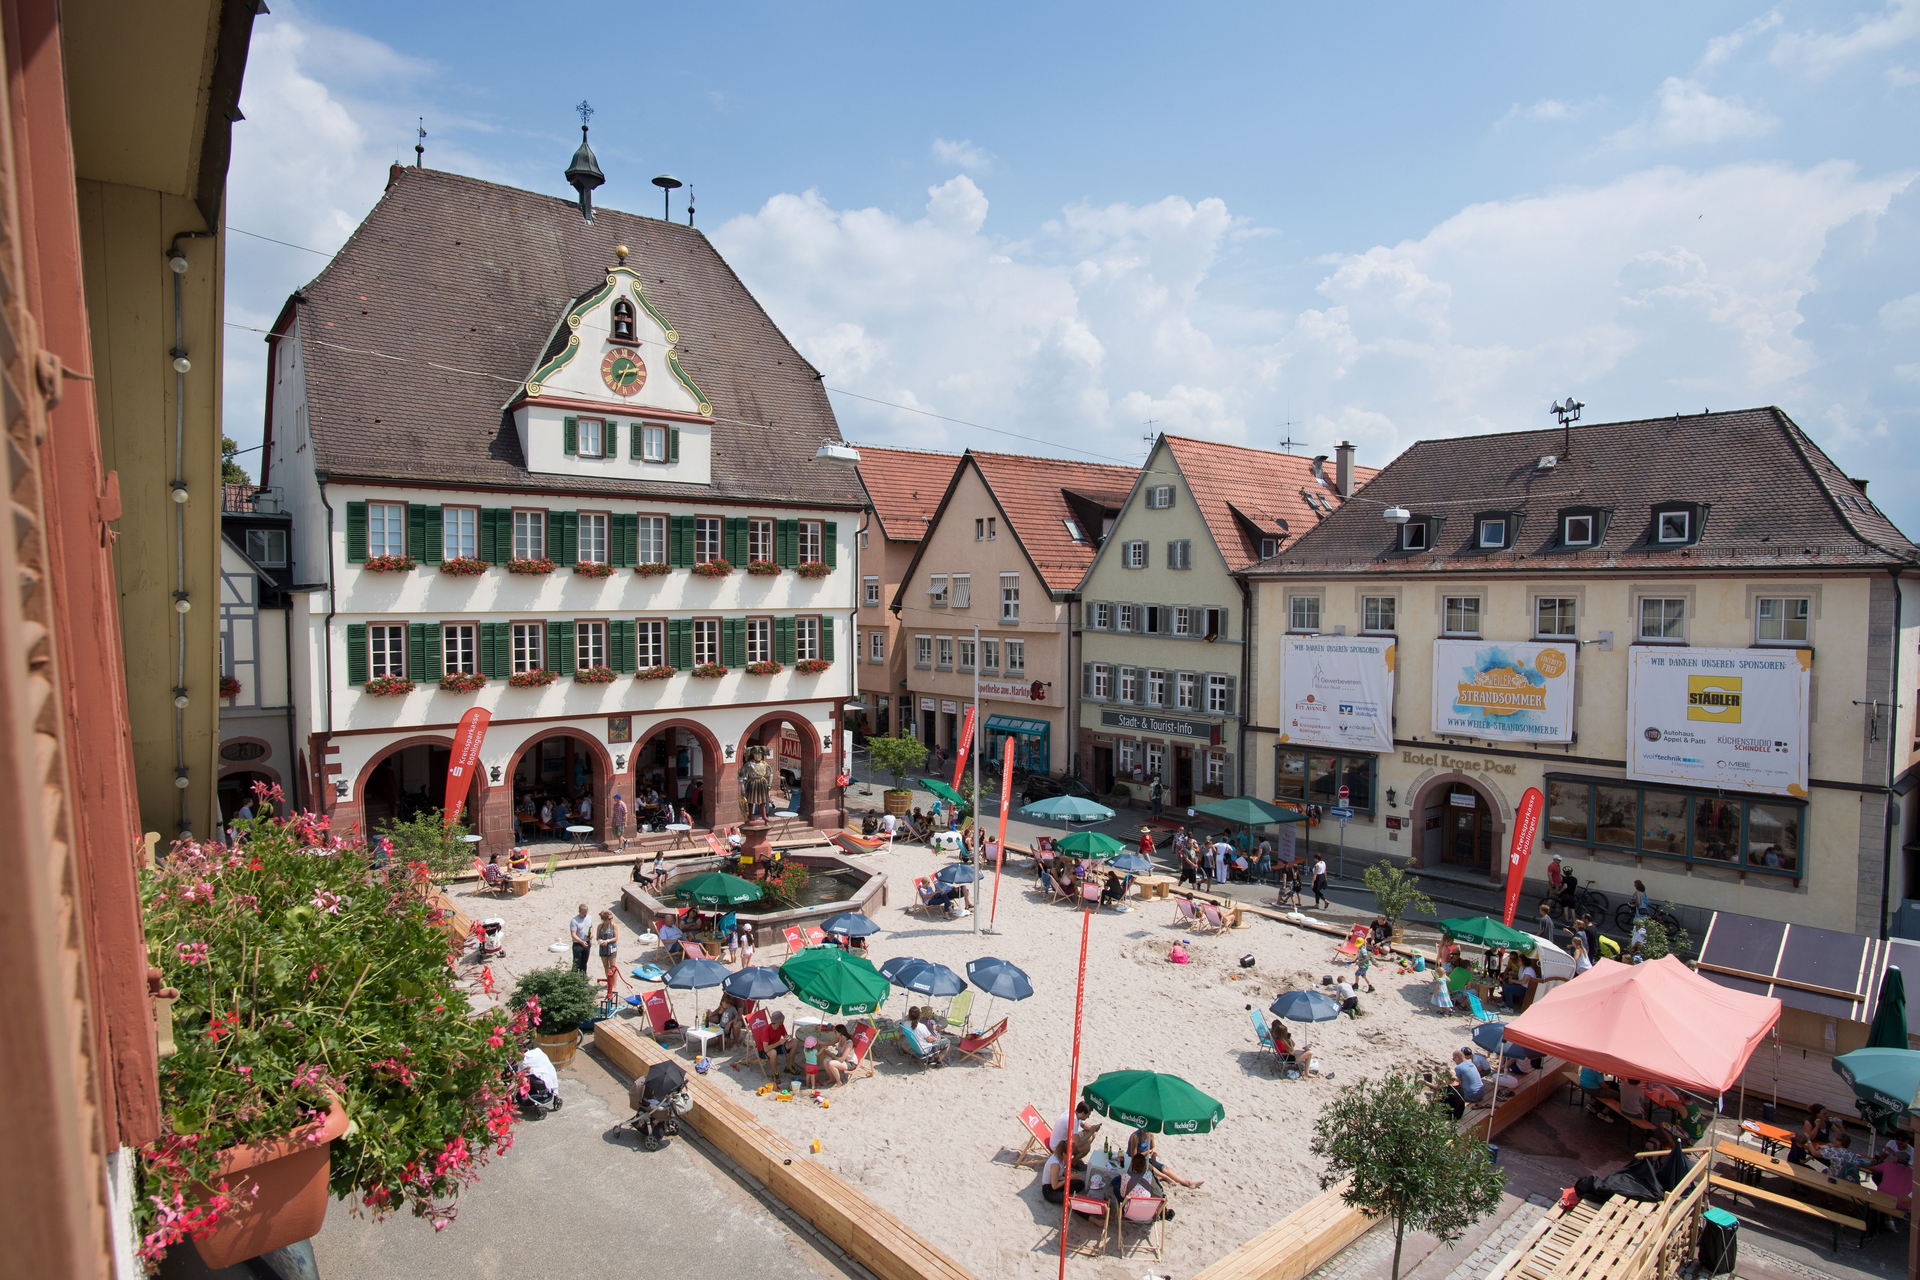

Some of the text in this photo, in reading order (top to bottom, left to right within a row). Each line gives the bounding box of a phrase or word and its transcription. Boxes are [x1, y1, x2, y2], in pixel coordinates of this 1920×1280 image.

[1541, 664, 1557, 674] FREI
[1651, 657, 1665, 666] WIR
[1669, 658, 1698, 667] DANKEN
[1702, 659, 1735, 668] UNSEREN
[1321, 677, 1361, 685] Gewerbeverein
[1488, 674, 1512, 686] WEILER
[1461, 690, 1542, 707] STRANDSOMMER
[1689, 692, 1740, 706] STÄBLER
[1118, 715, 1192, 735] Stadt- & Tourist-Info
[1447, 718, 1559, 735] WWW.WEILER-STRANDSOMMER.DE
[459, 713, 480, 764] Kreissparkasse
[1663, 736, 1682, 744] Appel
[1718, 736, 1772, 747] KÜCHENSTUDIO
[467, 730, 482, 766] Böblingen
[1734, 744, 1771, 753] SCHINDELE
[1402, 751, 1517, 775] Hotel Krone Post
[1643, 754, 1682, 762] wolftechnik
[1516, 794, 1536, 852] Kreissparkasse
